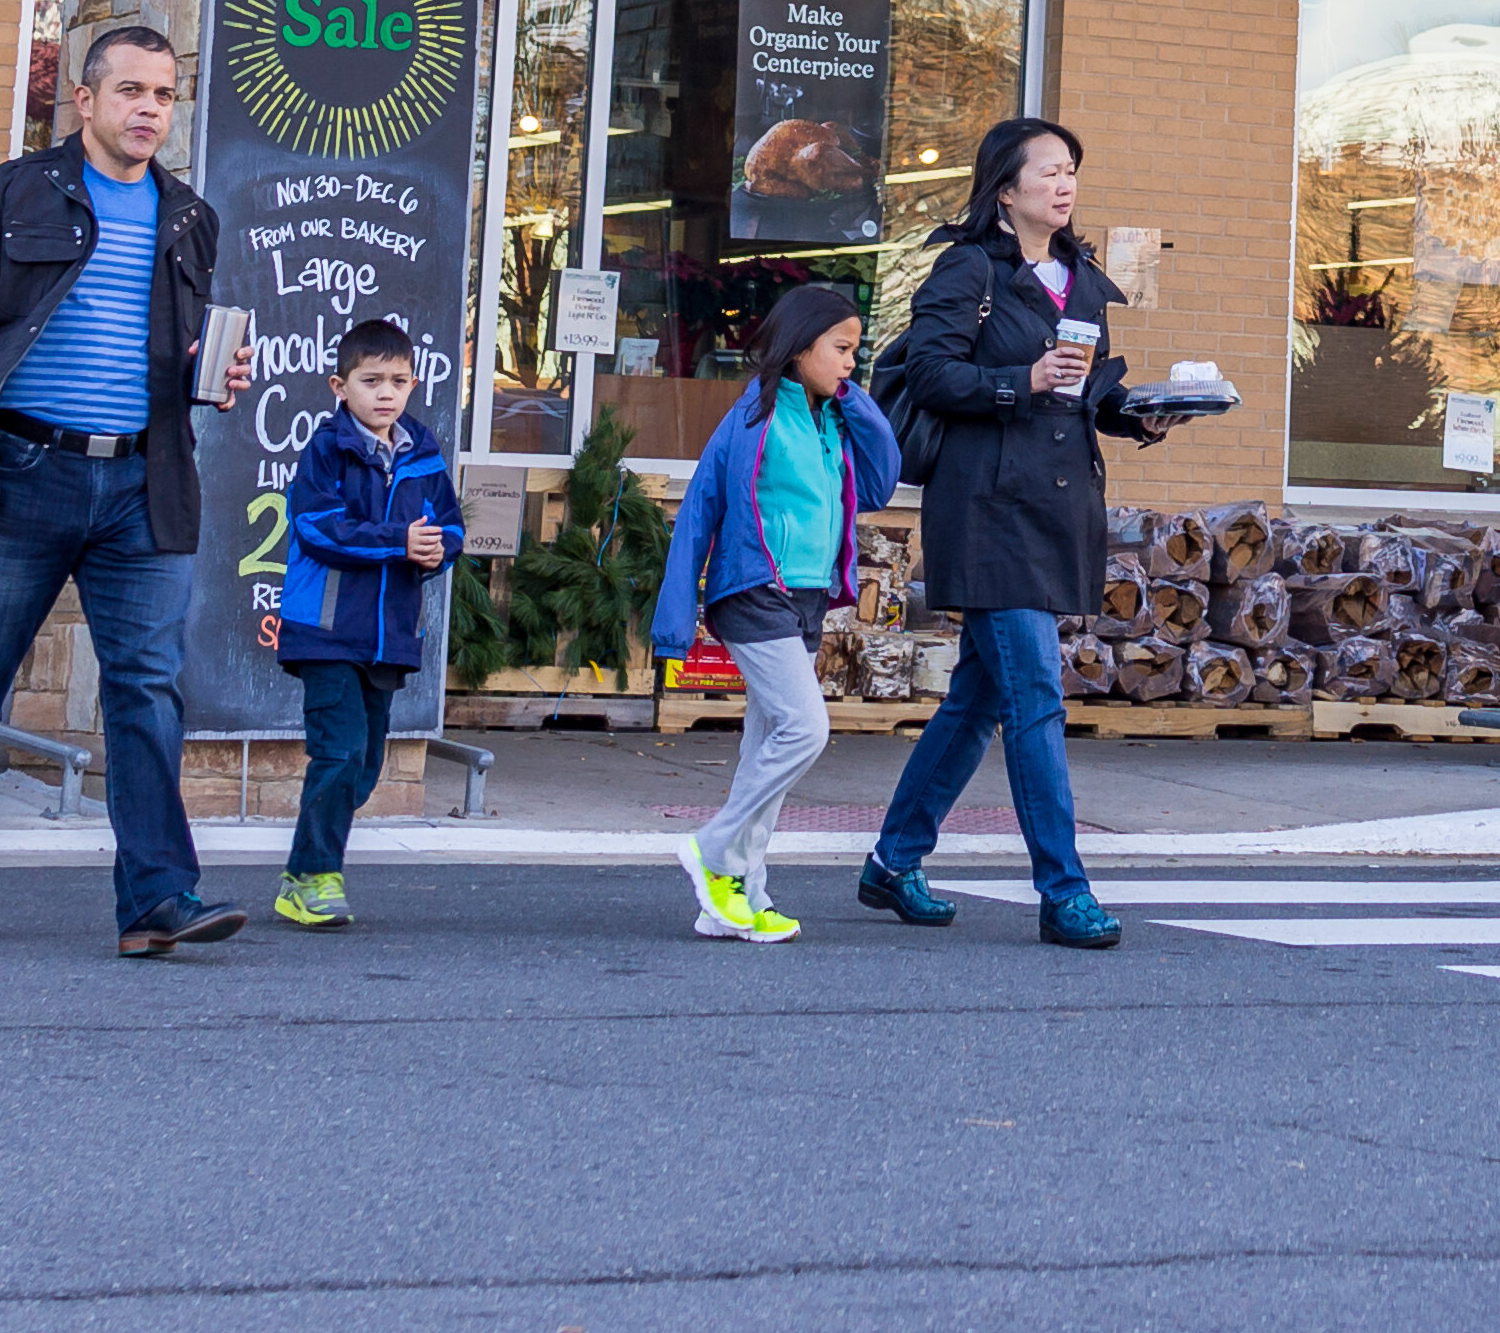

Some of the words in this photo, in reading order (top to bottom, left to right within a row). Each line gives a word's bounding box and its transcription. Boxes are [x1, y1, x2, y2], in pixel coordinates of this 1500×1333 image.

[788, 3, 843, 26] Make
[750, 26, 829, 52] Organic
[834, 32, 880, 54] Your
[753, 52, 875, 80] Centerpiece
[249, 226, 296, 251] FROM
[300, 219, 334, 238] OUR
[340, 217, 427, 263] BAKERY
[272, 249, 380, 315] Large
